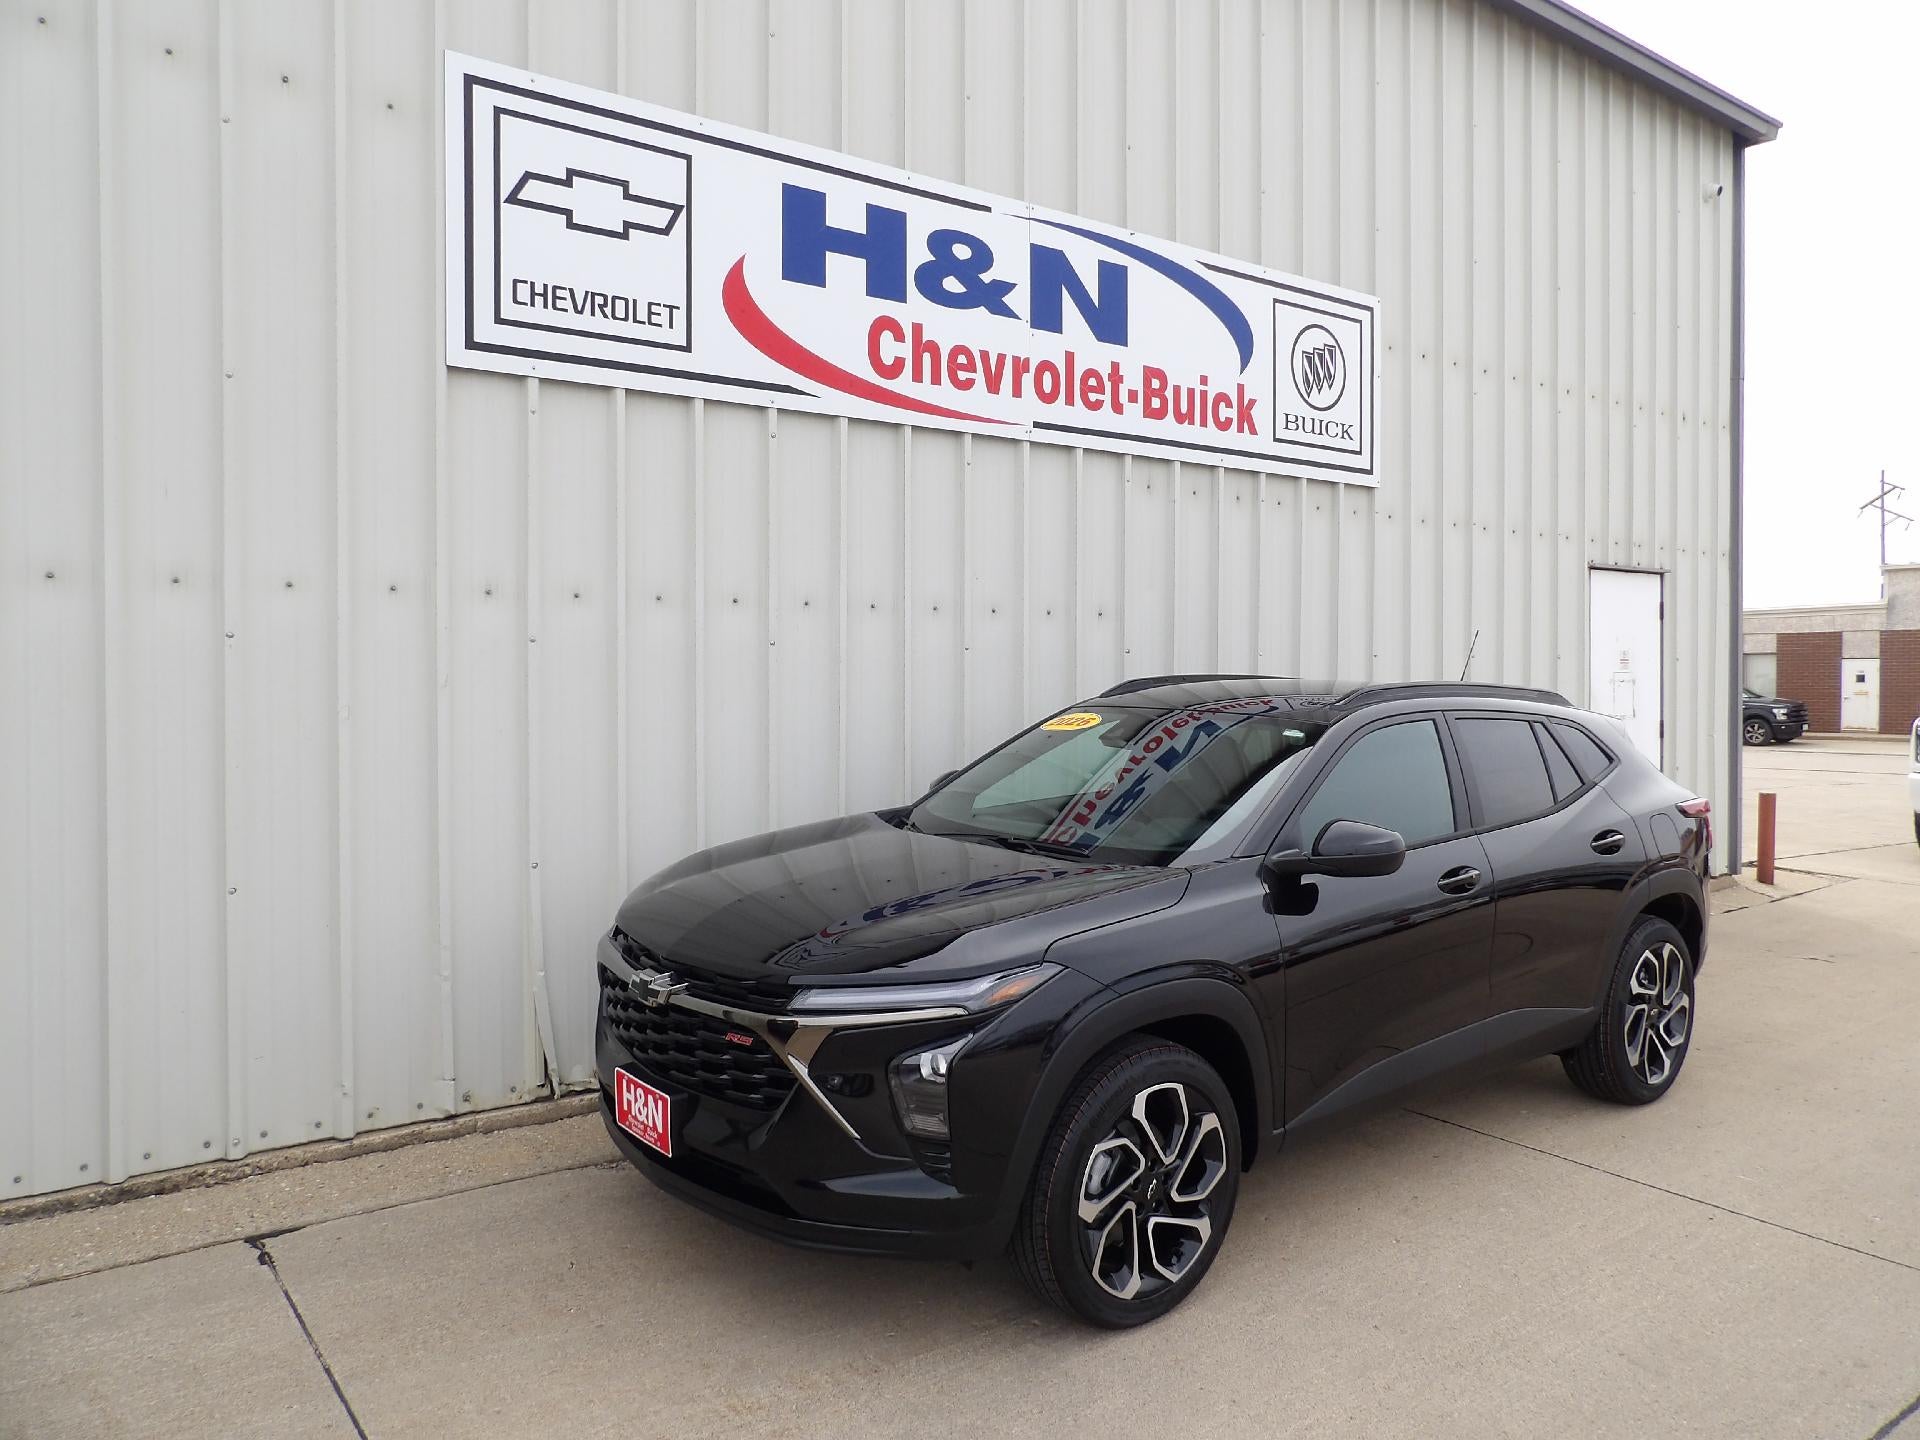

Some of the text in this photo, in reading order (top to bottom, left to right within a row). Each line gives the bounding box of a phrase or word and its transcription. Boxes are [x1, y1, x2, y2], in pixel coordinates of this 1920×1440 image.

[782, 183, 1128, 347] H&N
[512, 278, 680, 330] CHEVROLET
[867, 315, 1259, 435] Chevrolet-Buick
[1282, 412, 1354, 441] BUICK
[725, 1032, 753, 1046] RS
[622, 1078, 663, 1134] H&N
